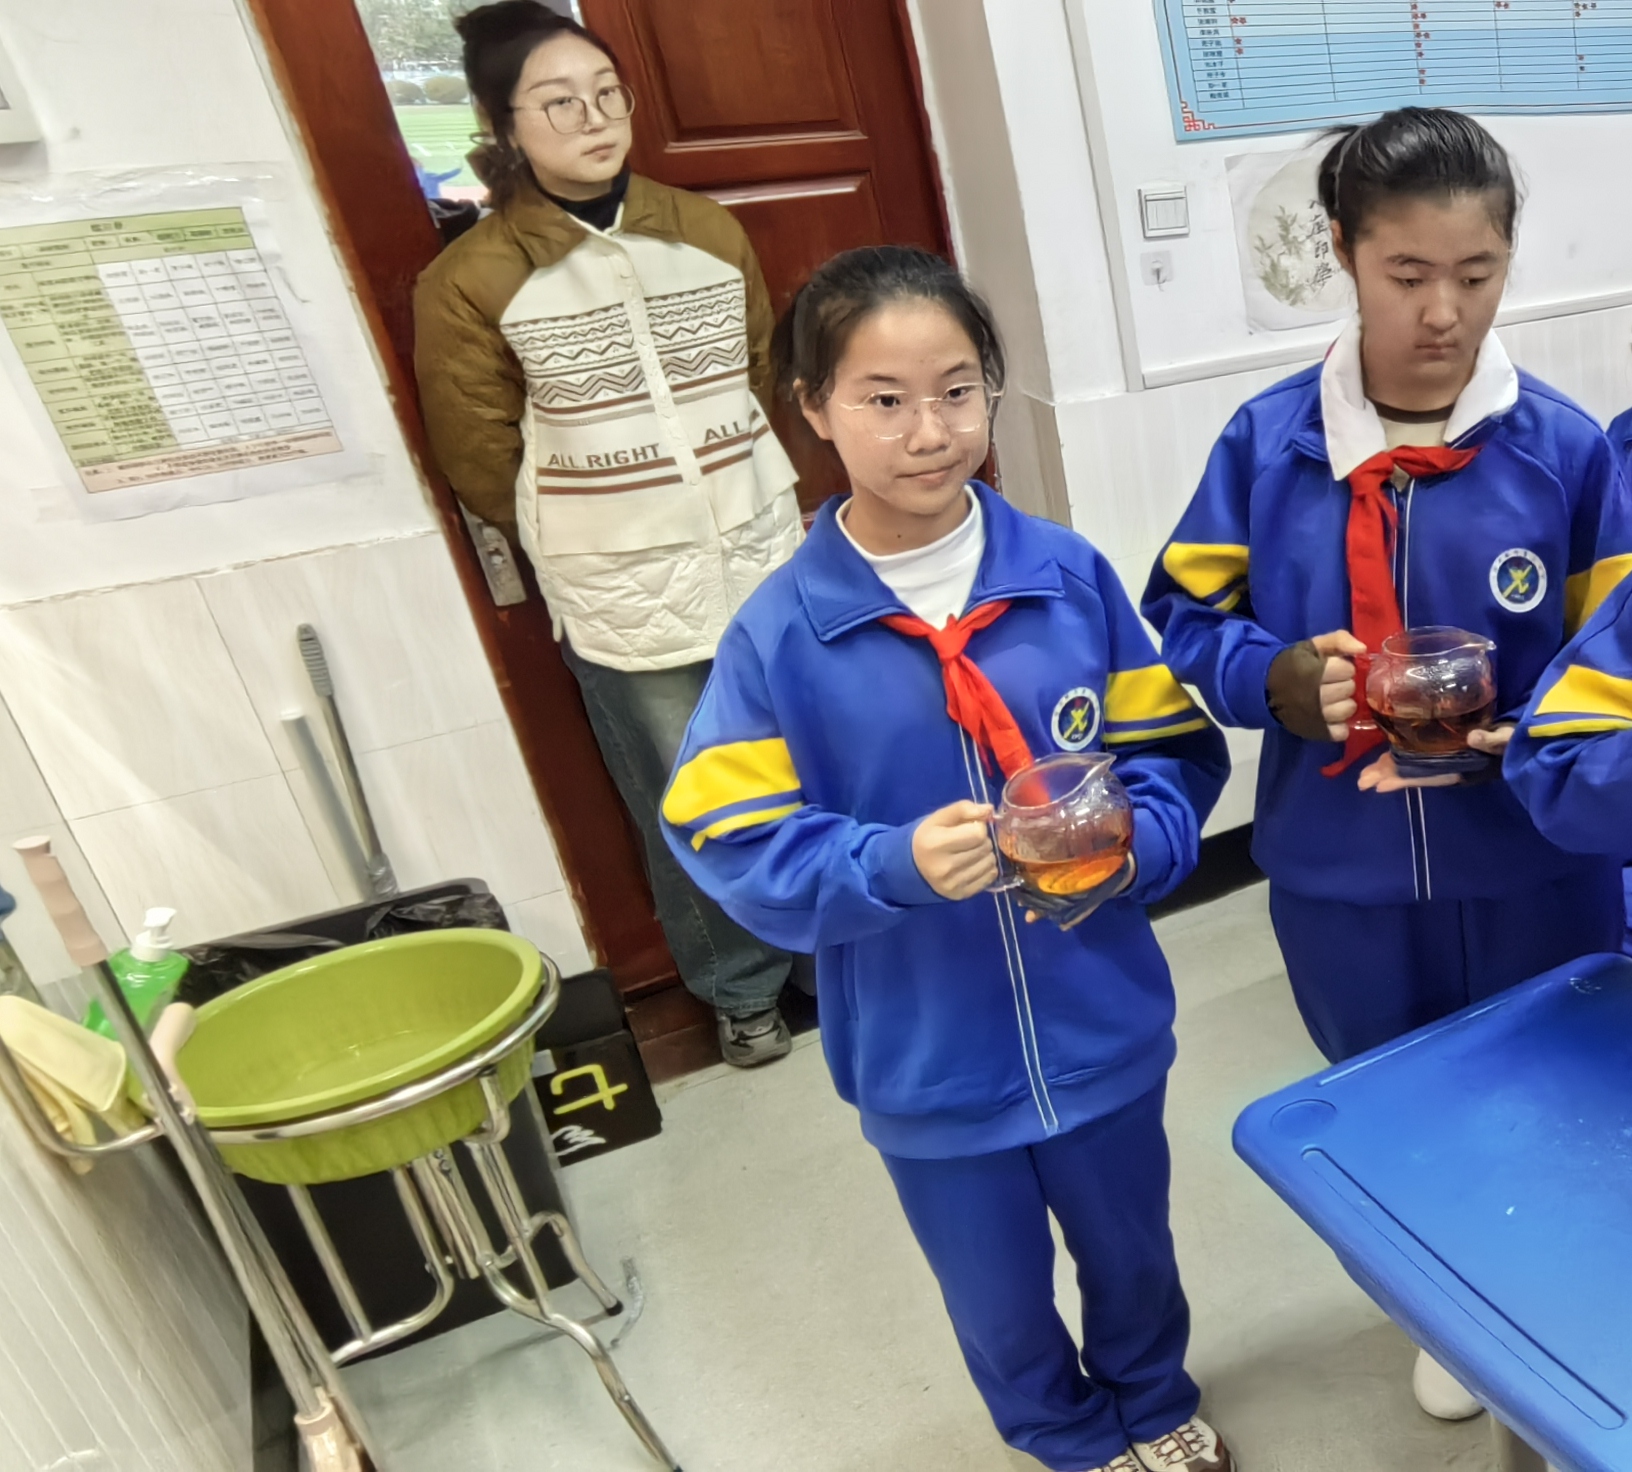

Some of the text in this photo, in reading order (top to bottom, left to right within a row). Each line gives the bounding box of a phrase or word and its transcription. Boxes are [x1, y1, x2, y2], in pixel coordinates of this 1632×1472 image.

[704, 421, 746, 445] ALL
[548, 443, 660, 469] ALL RIGHT
